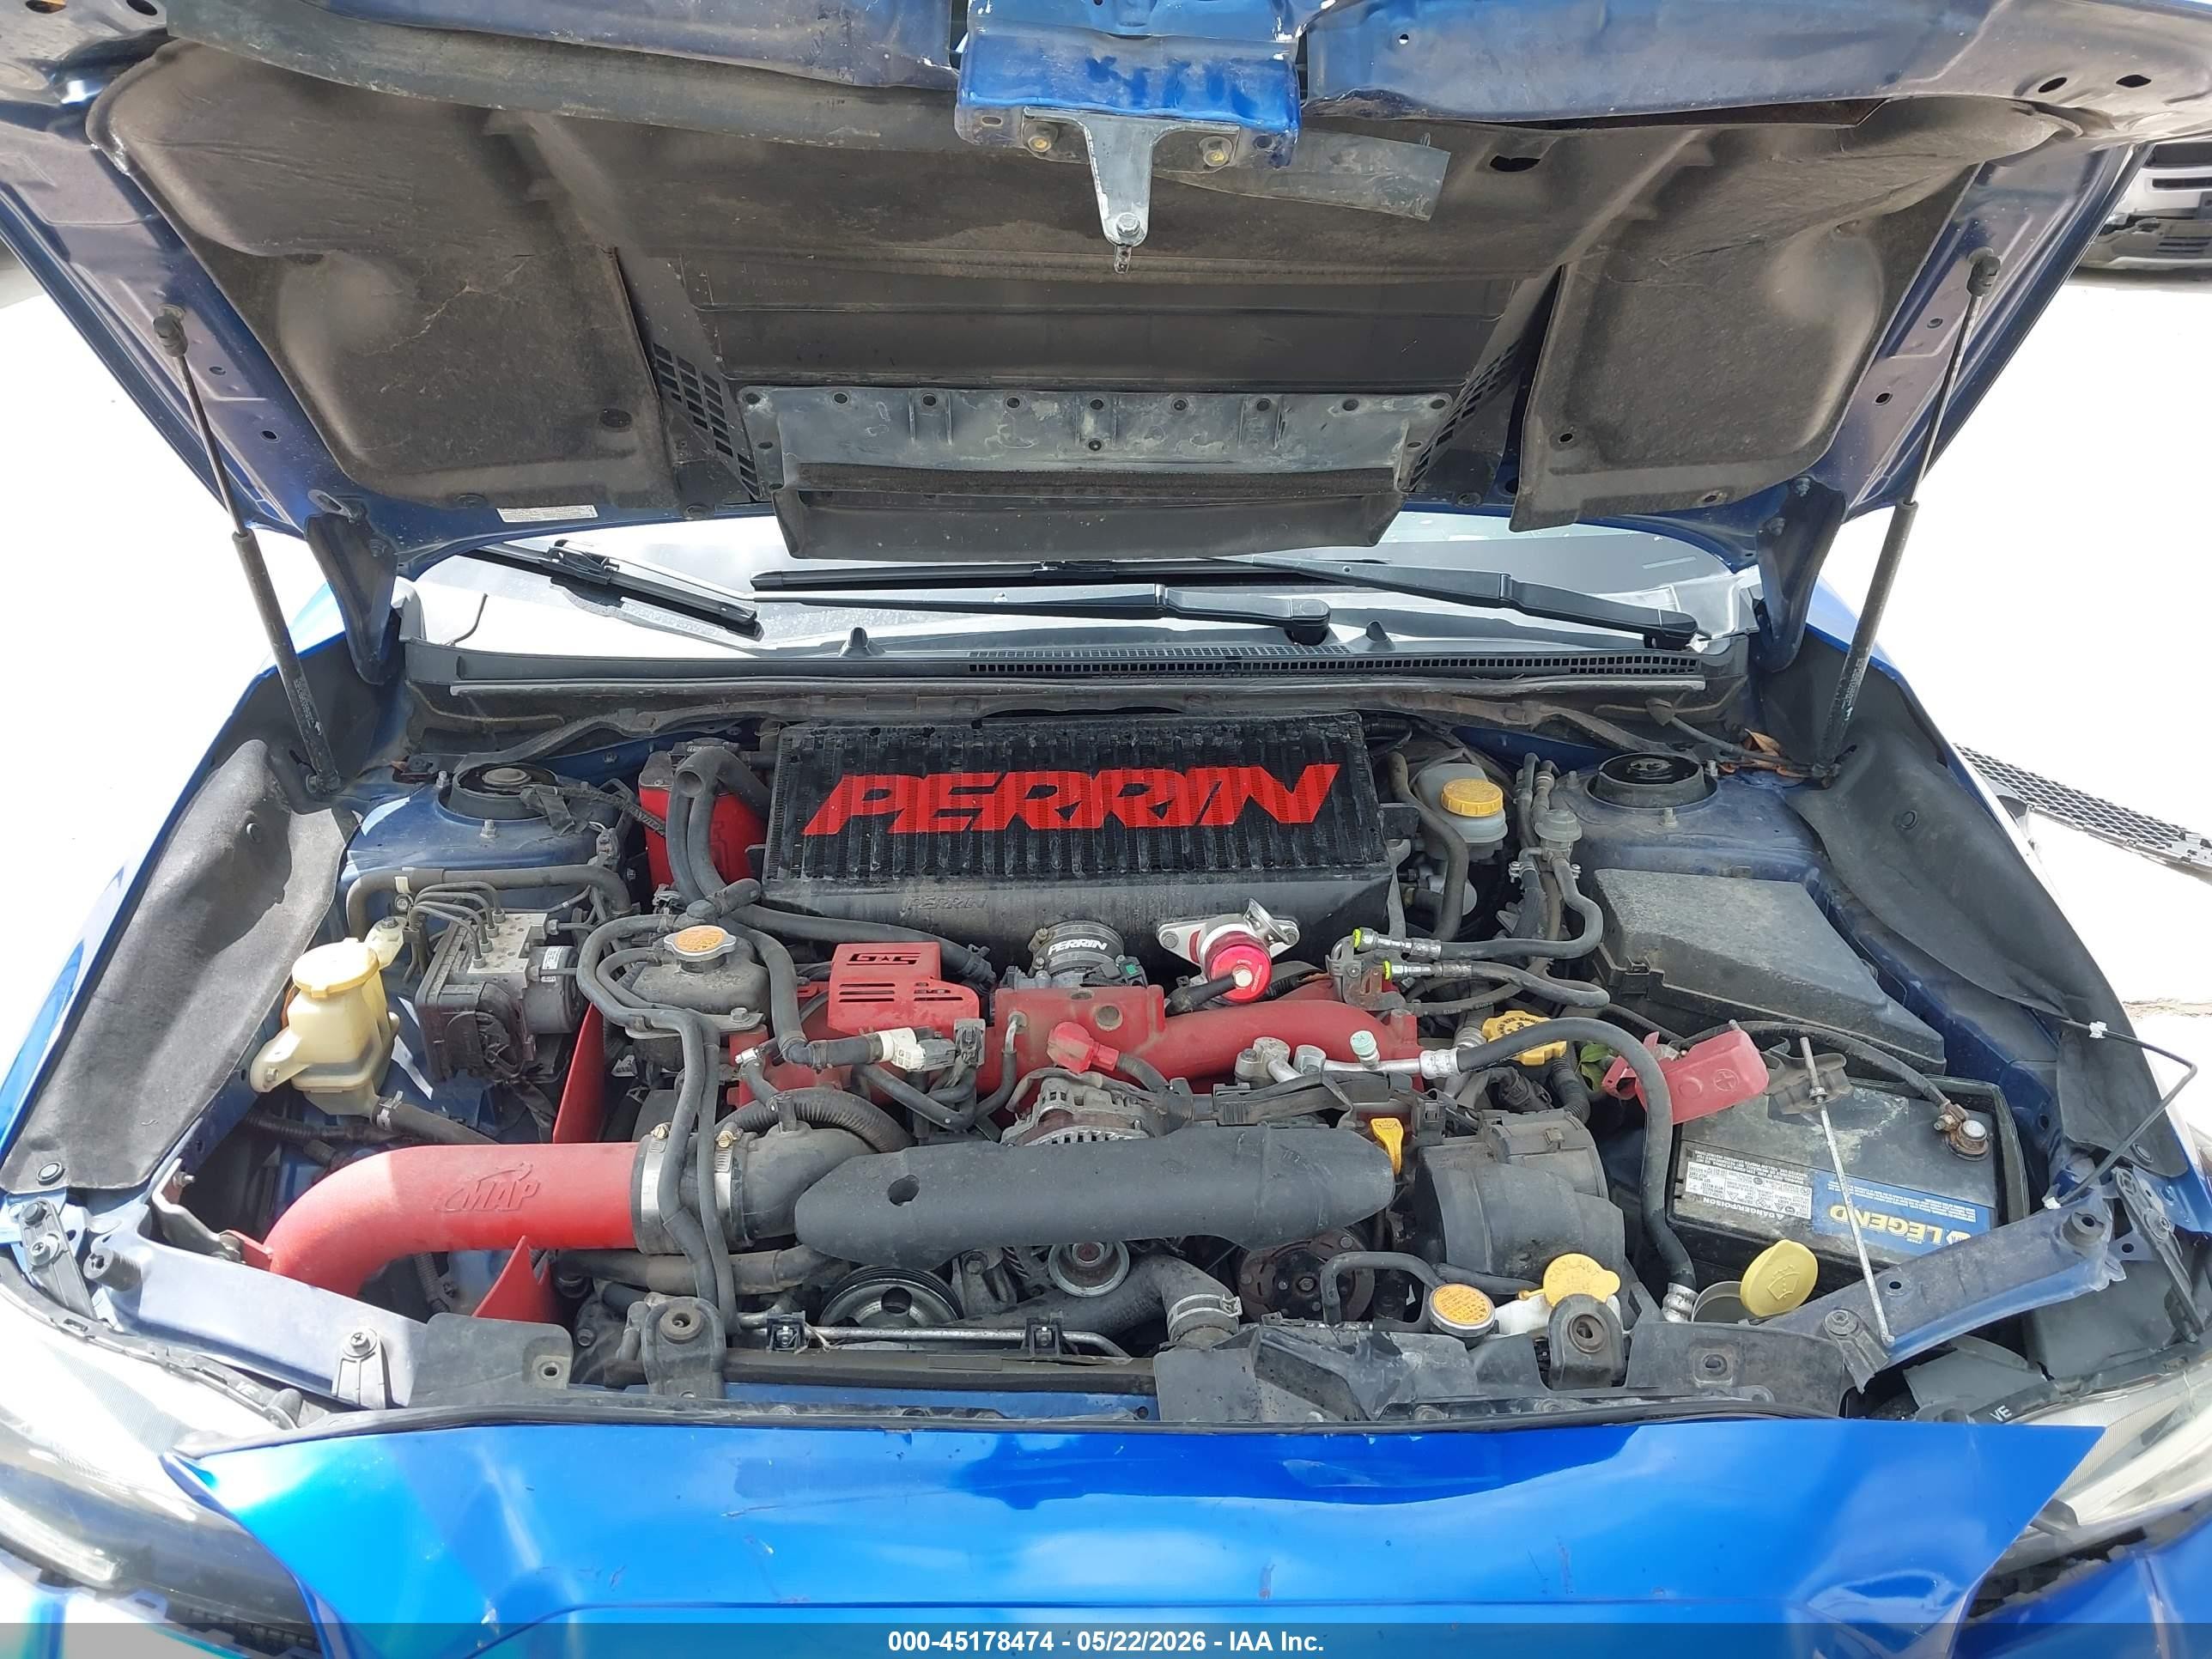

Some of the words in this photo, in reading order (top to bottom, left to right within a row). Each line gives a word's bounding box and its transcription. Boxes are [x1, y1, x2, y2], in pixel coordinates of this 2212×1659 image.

[801, 763, 1340, 836] PERRIN
[907, 894, 988, 911] PERRIN
[1048, 939, 1108, 956] PERRIN
[1703, 1197, 1776, 1218] DANGER/POISON
[1830, 1205, 1944, 1245] LEGEND
[1548, 1259, 1600, 1283] COOLANT
[1989, 1405, 2013, 1422] VE
